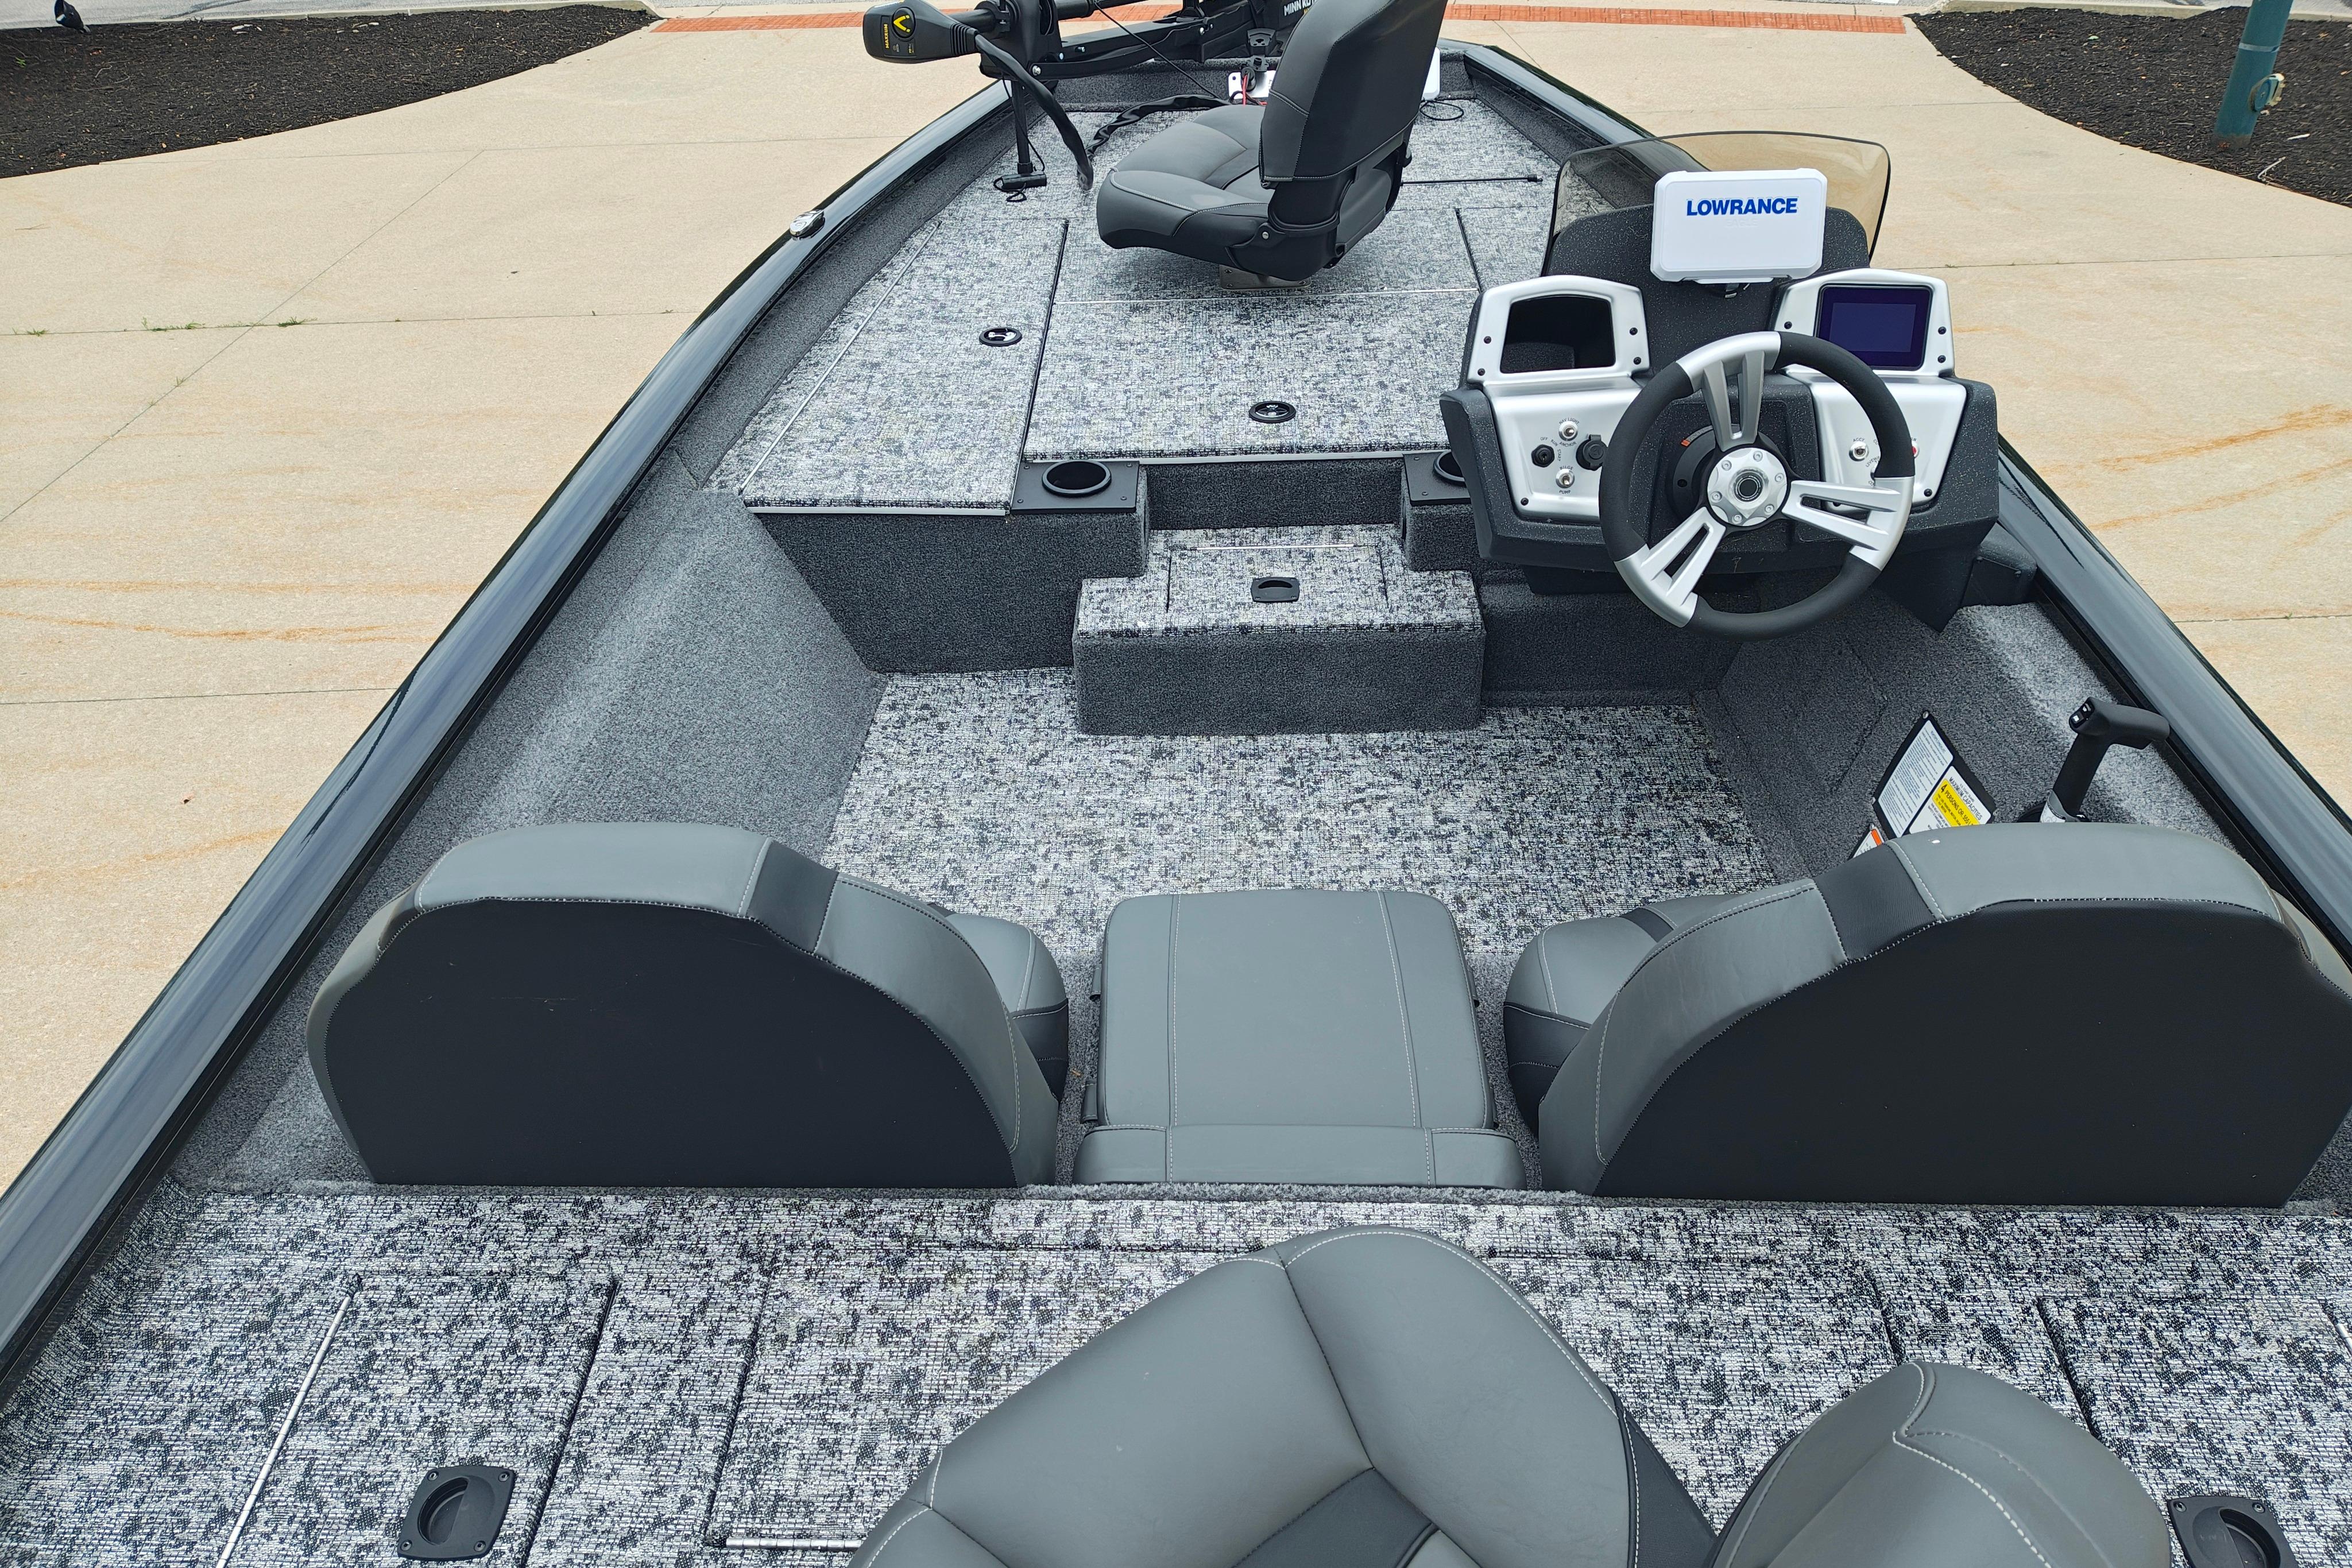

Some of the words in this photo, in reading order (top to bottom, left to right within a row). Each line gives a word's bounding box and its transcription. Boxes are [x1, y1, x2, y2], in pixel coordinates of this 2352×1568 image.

[1284, 0, 1302, 16] MINN
[1686, 198, 1798, 216] LOWRANCE
[1726, 218, 1758, 228] EAGLE
[1550, 439, 1558, 447] RUN
[1940, 784, 1948, 793] 4
[1945, 790, 1959, 810] PERSONS
[1958, 808, 1964, 816] OR
[1949, 777, 1964, 797] MAXIMUM
[1963, 795, 1982, 820] CAPACITIES
